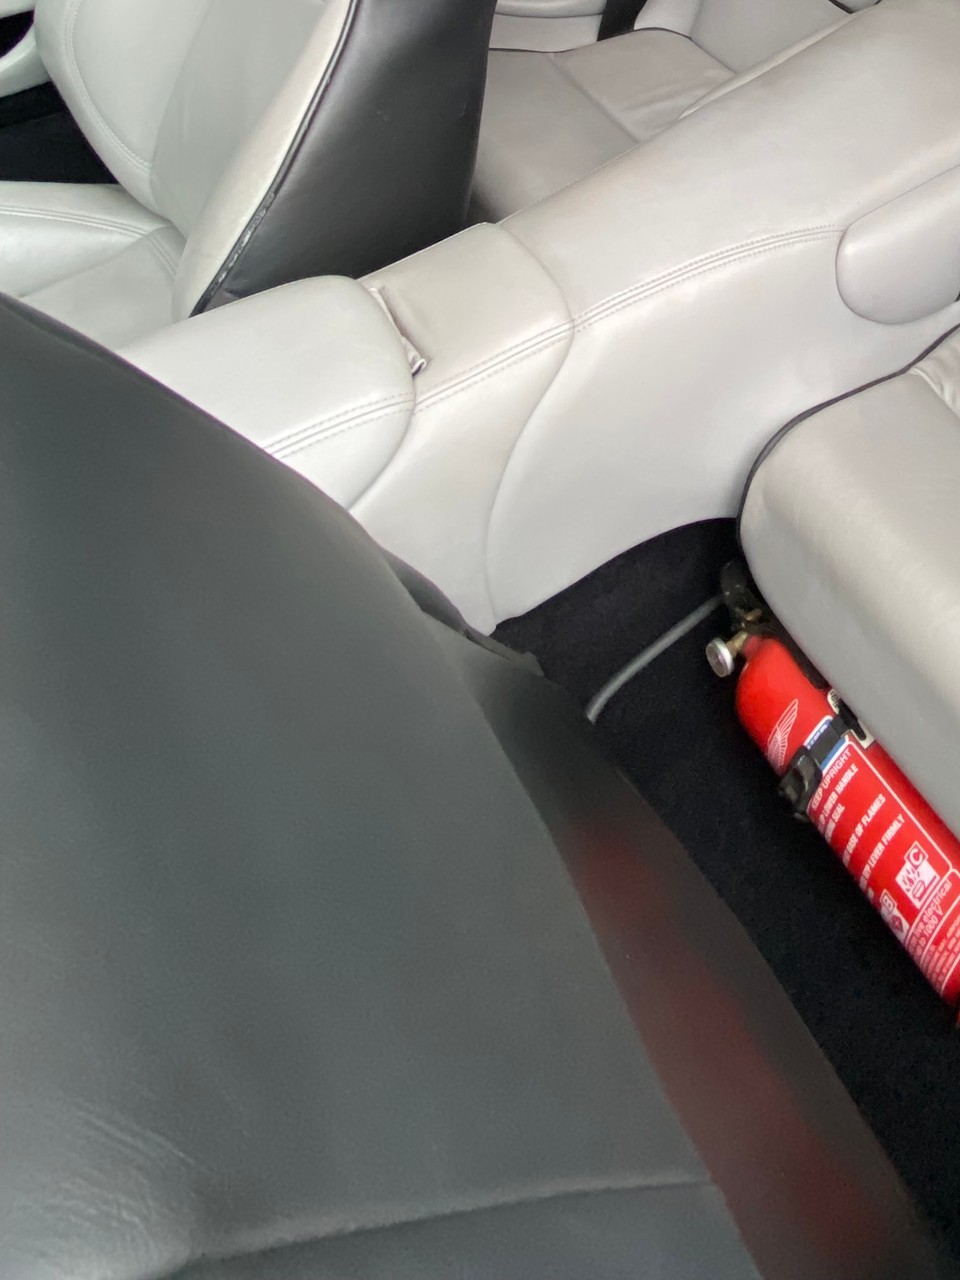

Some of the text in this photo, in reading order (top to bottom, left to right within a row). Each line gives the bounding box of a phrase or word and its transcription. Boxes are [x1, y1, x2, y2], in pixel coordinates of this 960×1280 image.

[821, 747, 851, 789] UPRIGHT
[821, 791, 838, 816] LOWER
[835, 763, 858, 794] HANDLE
[830, 803, 845, 822] SEAL
[853, 821, 864, 837] OF
[860, 793, 886, 826] FLAMES
[867, 841, 885, 867] LEVER
[880, 812, 904, 845] FIRMLY
[921, 880, 952, 922] electrical
[922, 914, 939, 937] 1000
